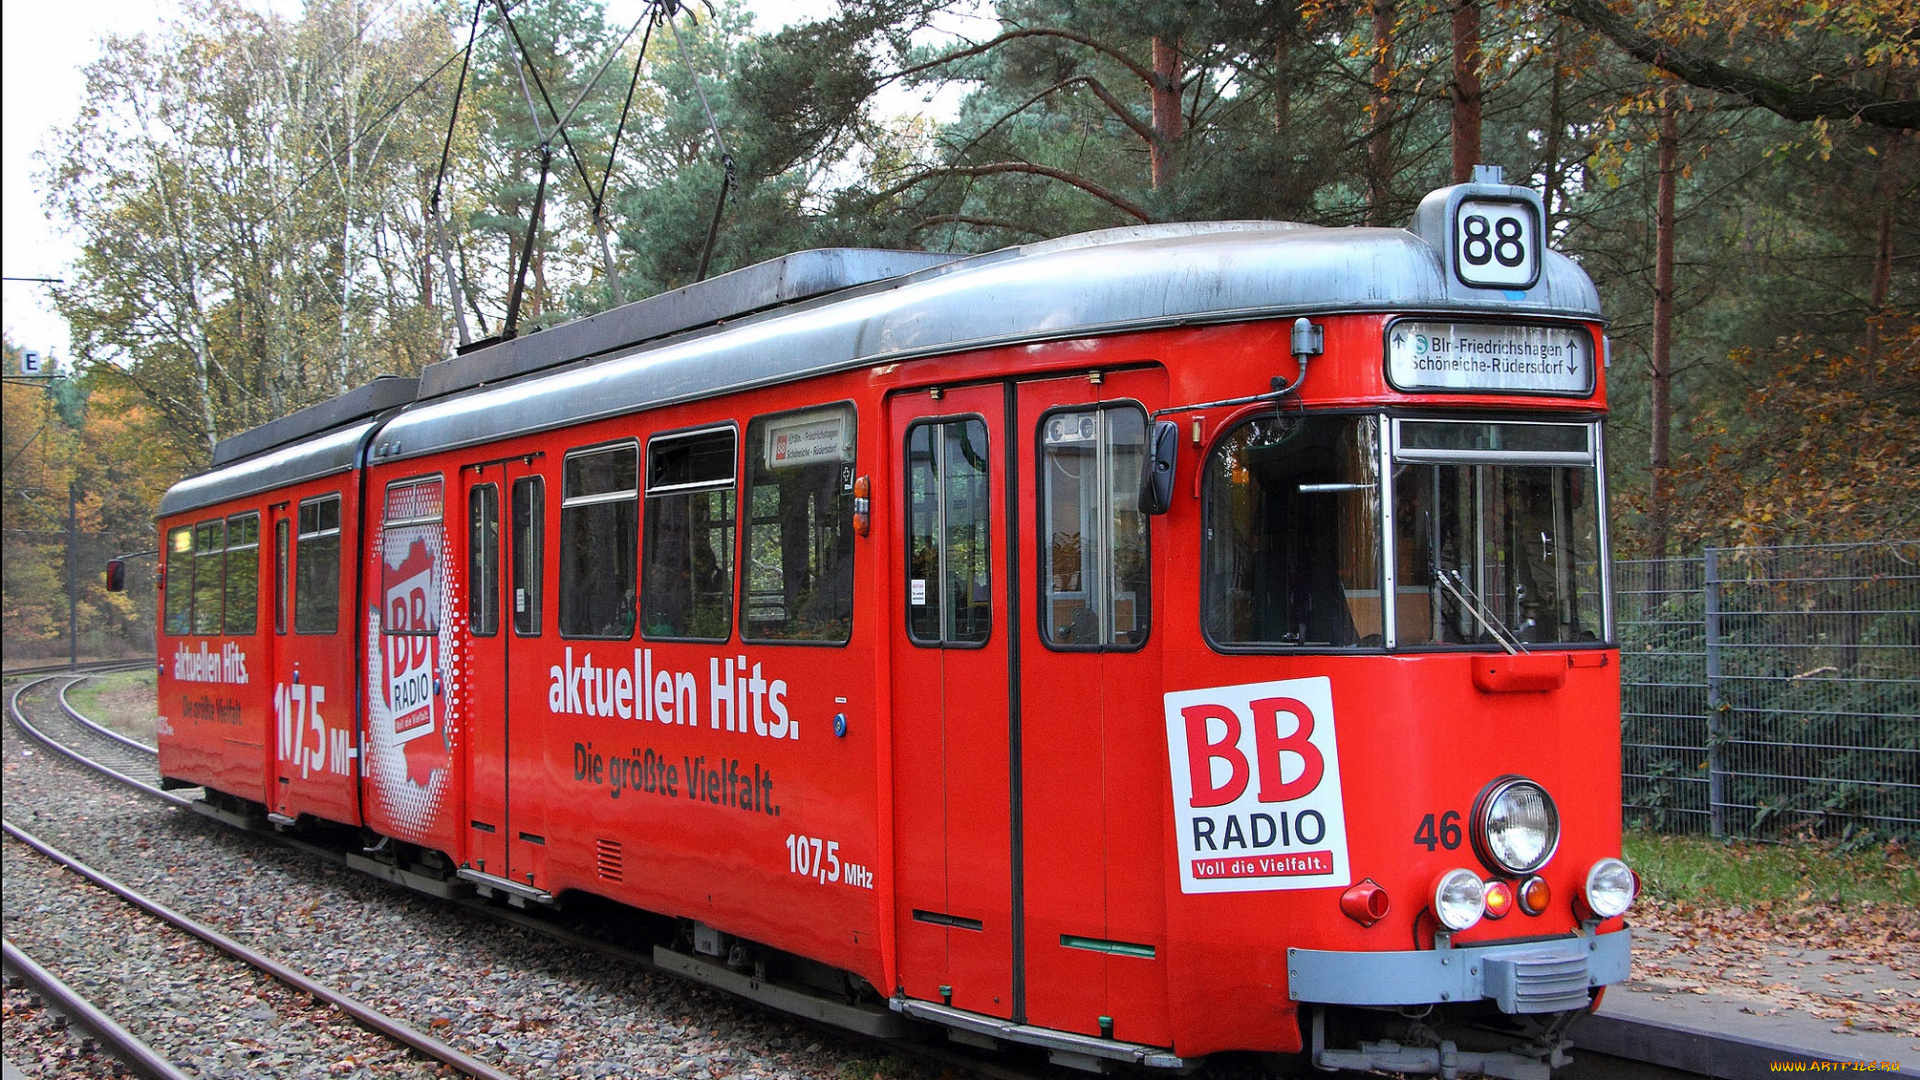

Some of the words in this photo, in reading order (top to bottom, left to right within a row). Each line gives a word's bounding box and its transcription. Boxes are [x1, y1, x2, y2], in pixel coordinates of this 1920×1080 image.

[1463, 215, 1525, 267] 88
[27, 354, 37, 370] E
[392, 586, 428, 678] BB
[174, 640, 222, 683] aktuellen
[223, 640, 249, 684] Hits.
[394, 672, 429, 713] RADIO
[548, 646, 698, 727] aktuellen
[709, 654, 800, 740] Hits.
[274, 682, 326, 779] 107,5
[1180, 696, 1324, 808] BB
[574, 741, 604, 785] Die
[608, 748, 680, 800] größte
[684, 755, 781, 817] Vielfalt.
[1192, 809, 1326, 852] RADIO
[1413, 810, 1462, 852] 46
[785, 833, 840, 886] 107,5
[844, 862, 874, 890] MHz
[1196, 858, 1226, 876] Voll
[1231, 860, 1255, 875] die
[1259, 855, 1328, 873] Vielfalt.
